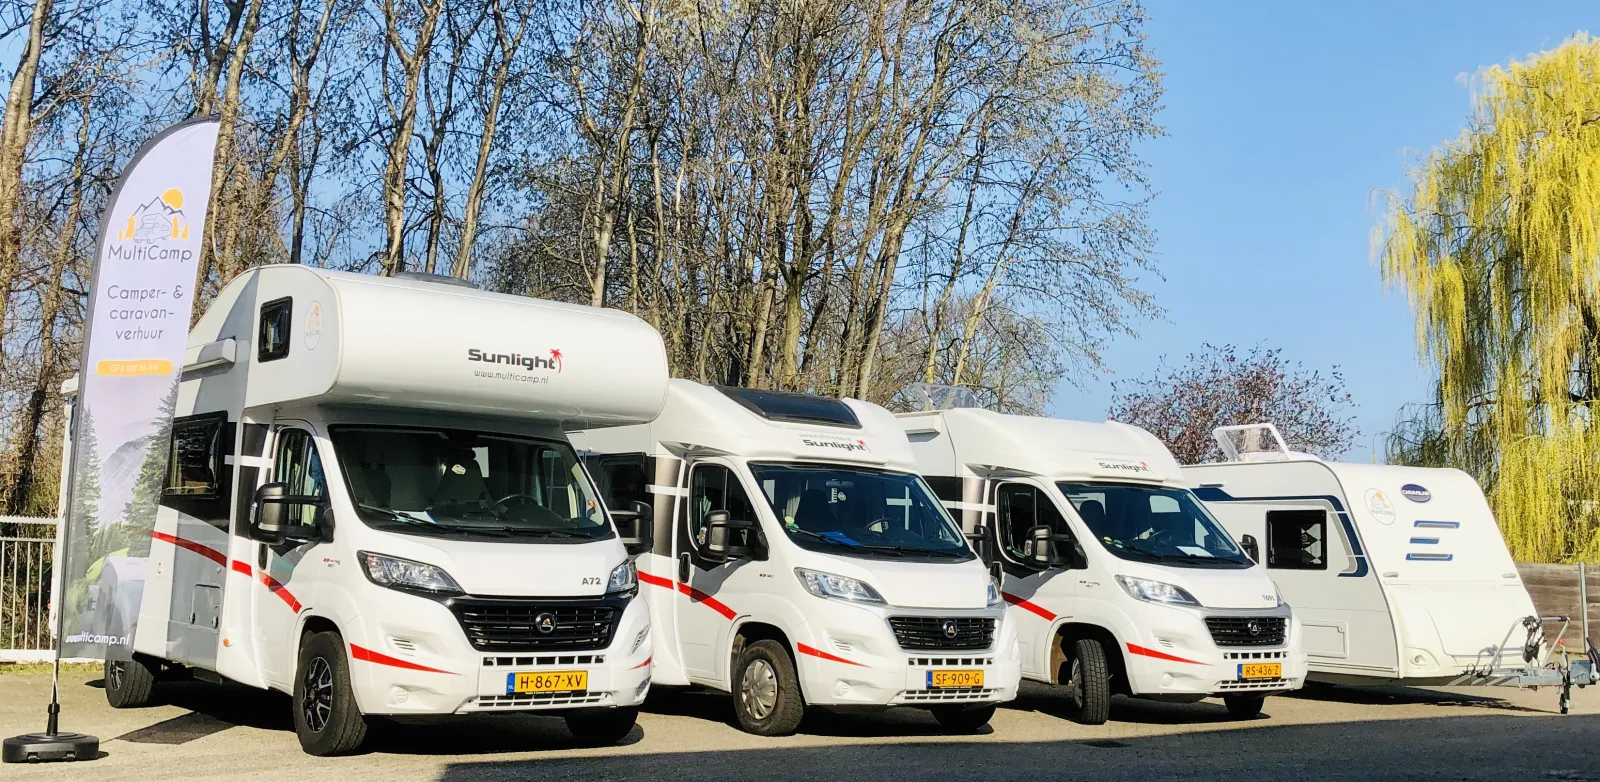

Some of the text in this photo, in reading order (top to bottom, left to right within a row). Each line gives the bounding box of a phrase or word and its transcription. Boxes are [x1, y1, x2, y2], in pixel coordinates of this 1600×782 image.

[107, 244, 193, 263] MultiCamp
[107, 284, 184, 302] Camper- &
[109, 308, 175, 320] caravan-
[115, 325, 164, 340] verhuur
[467, 348, 556, 371] Sunlight
[473, 370, 549, 384] www.multicamp.nl
[802, 438, 866, 452] Sunlight
[1098, 462, 1150, 473] Sunlight
[581, 577, 602, 586] A72
[1245, 665, 1280, 676] RS-436-Z
[520, 674, 583, 690] H-867-XV
[935, 673, 981, 685] SF-909-G
